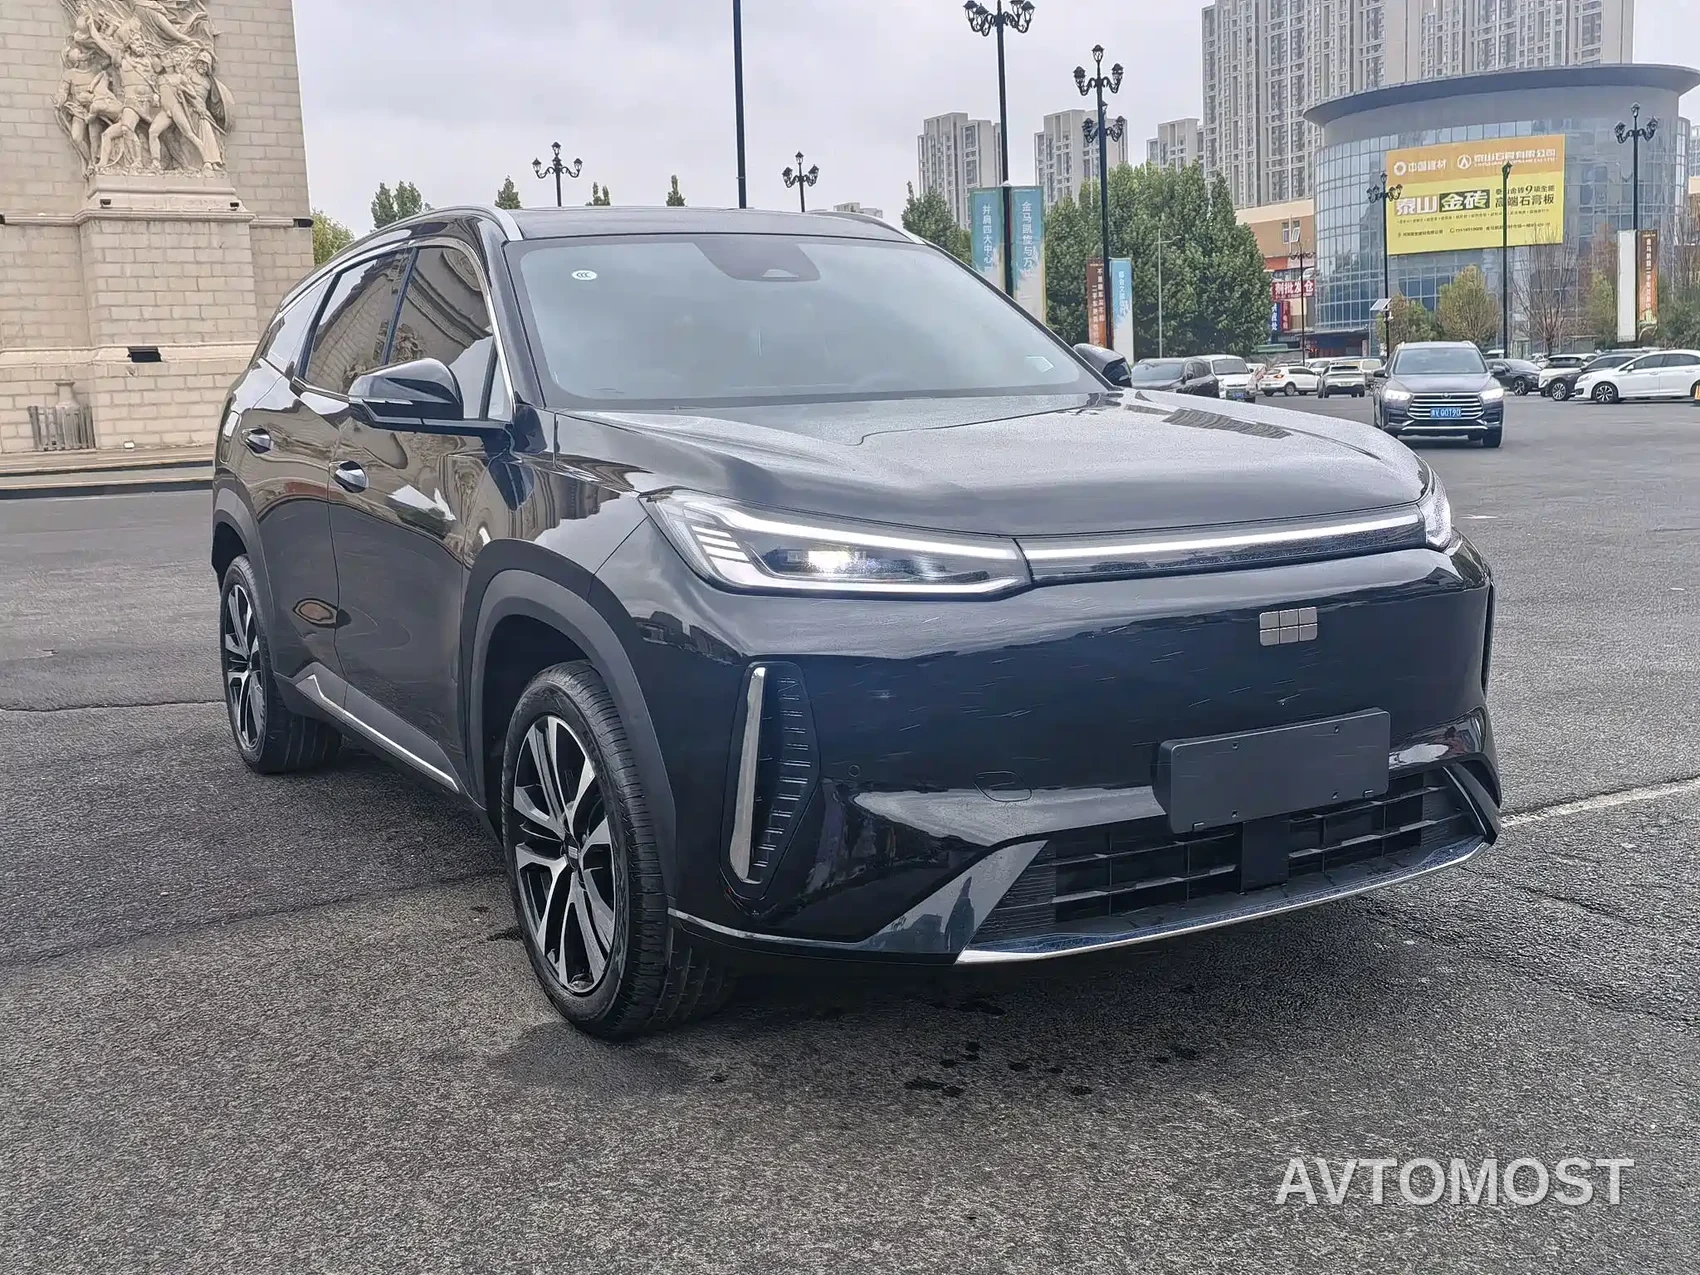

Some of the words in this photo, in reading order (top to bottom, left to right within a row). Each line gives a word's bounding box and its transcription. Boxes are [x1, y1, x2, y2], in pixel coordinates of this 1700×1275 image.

[1408, 158, 1447, 173] 中国建材
[1495, 185, 1555, 196] 泰金砖9项全能
[1396, 190, 1488, 216] 泰山金砖
